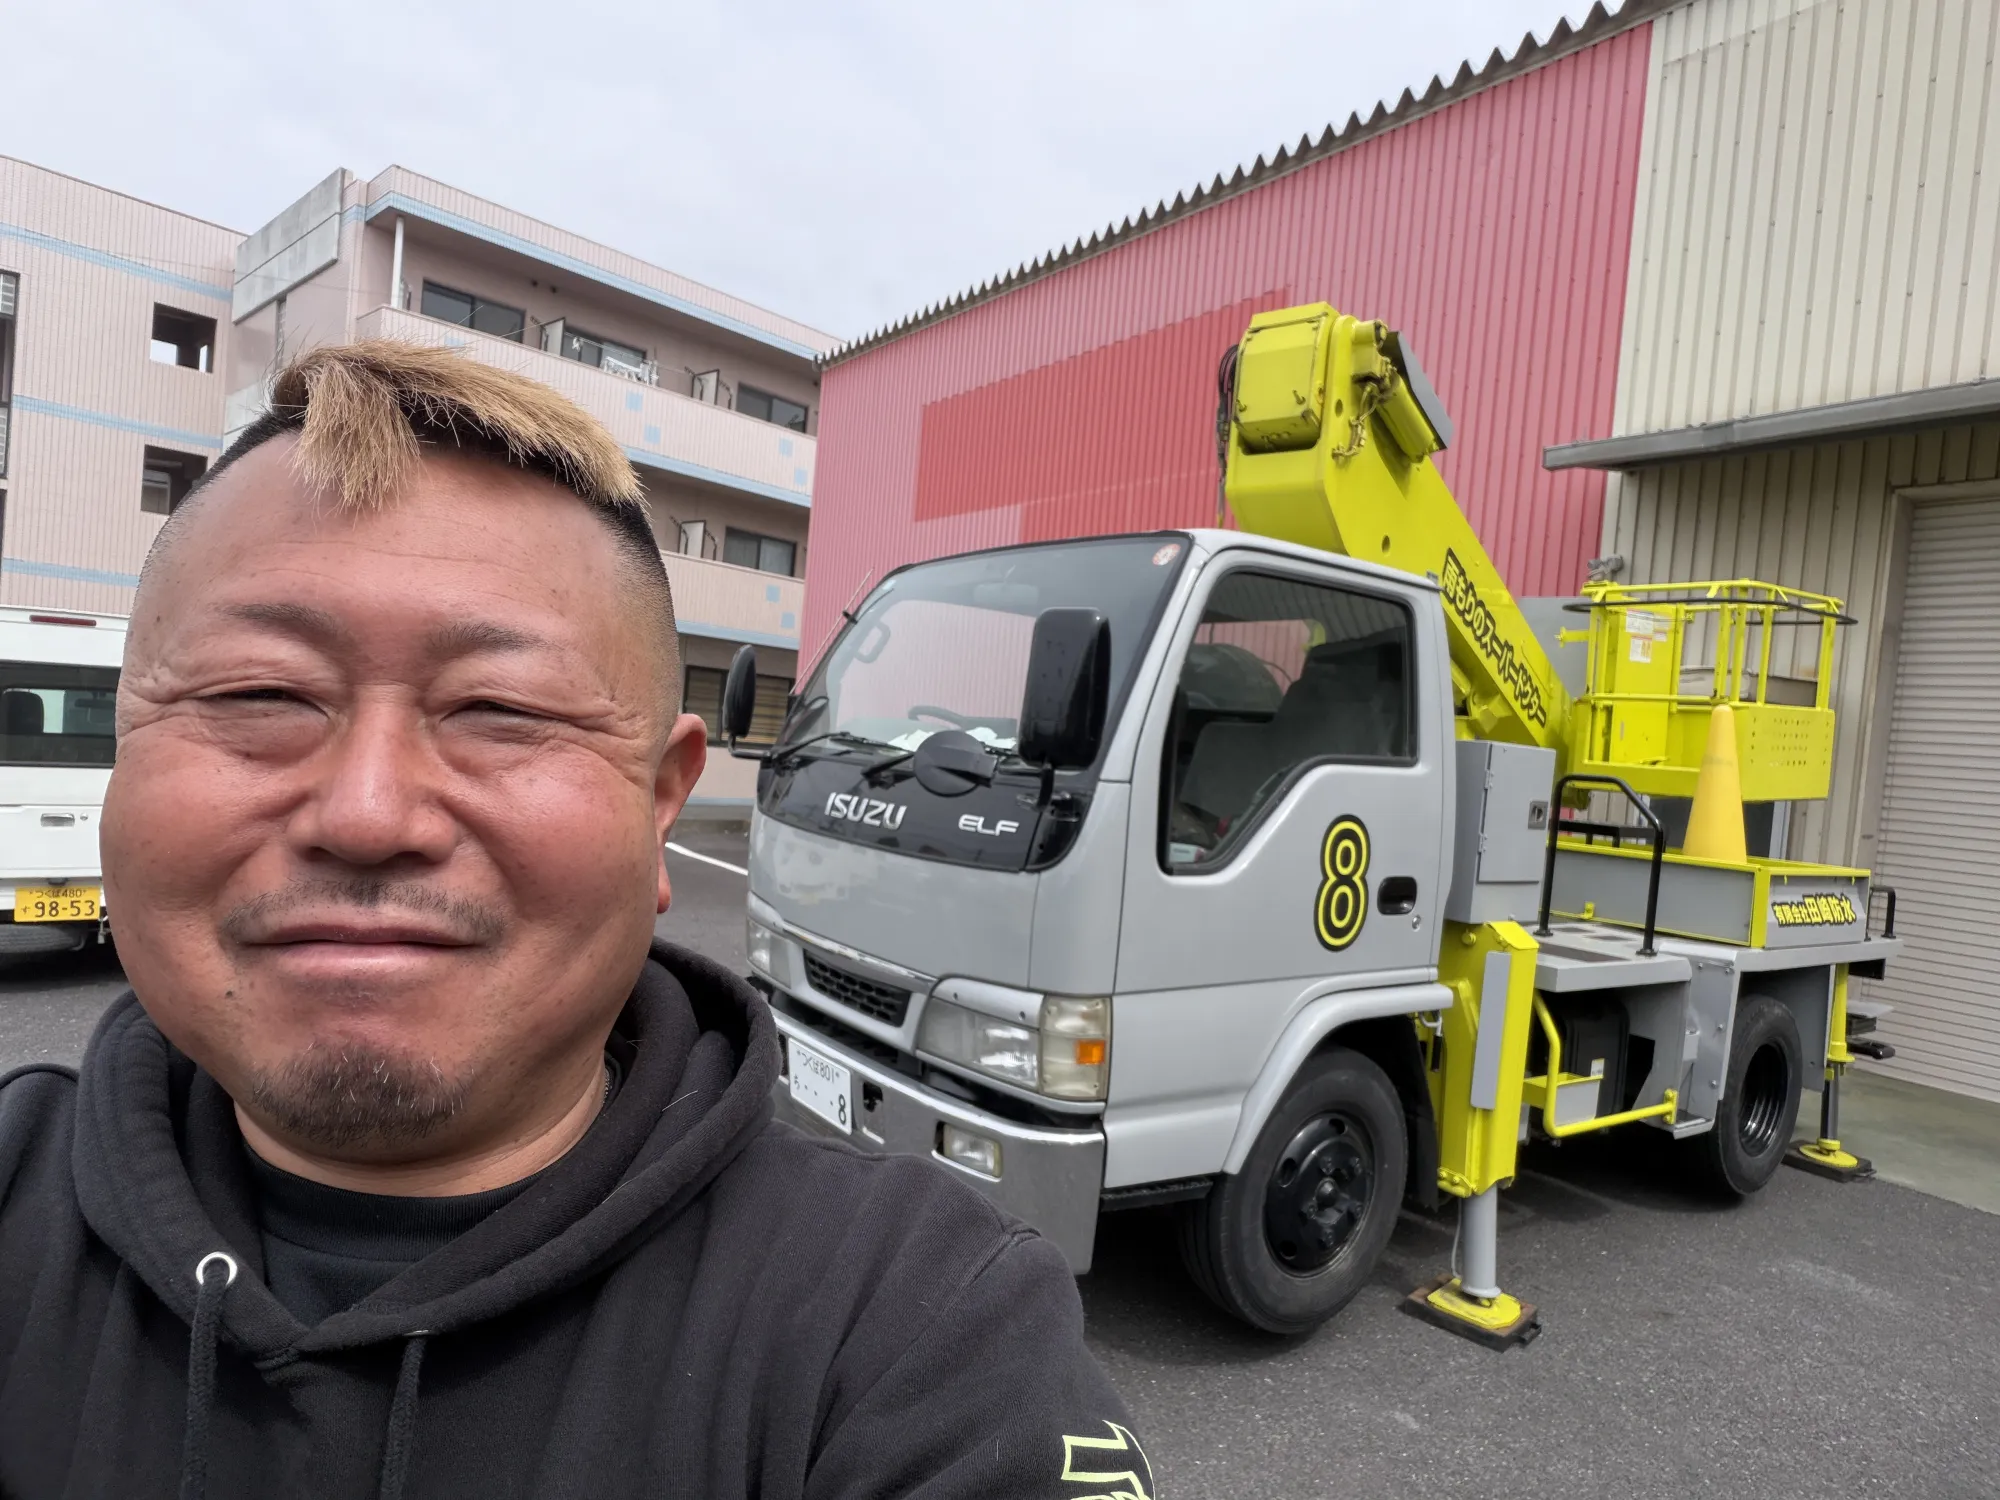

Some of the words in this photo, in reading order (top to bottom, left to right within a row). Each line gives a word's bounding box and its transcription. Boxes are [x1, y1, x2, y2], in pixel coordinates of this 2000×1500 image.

[824, 792, 907, 830] ISUZU
[958, 814, 1020, 836] ELF
[1314, 813, 1371, 953] 8
[35, 900, 95, 917] 98-53
